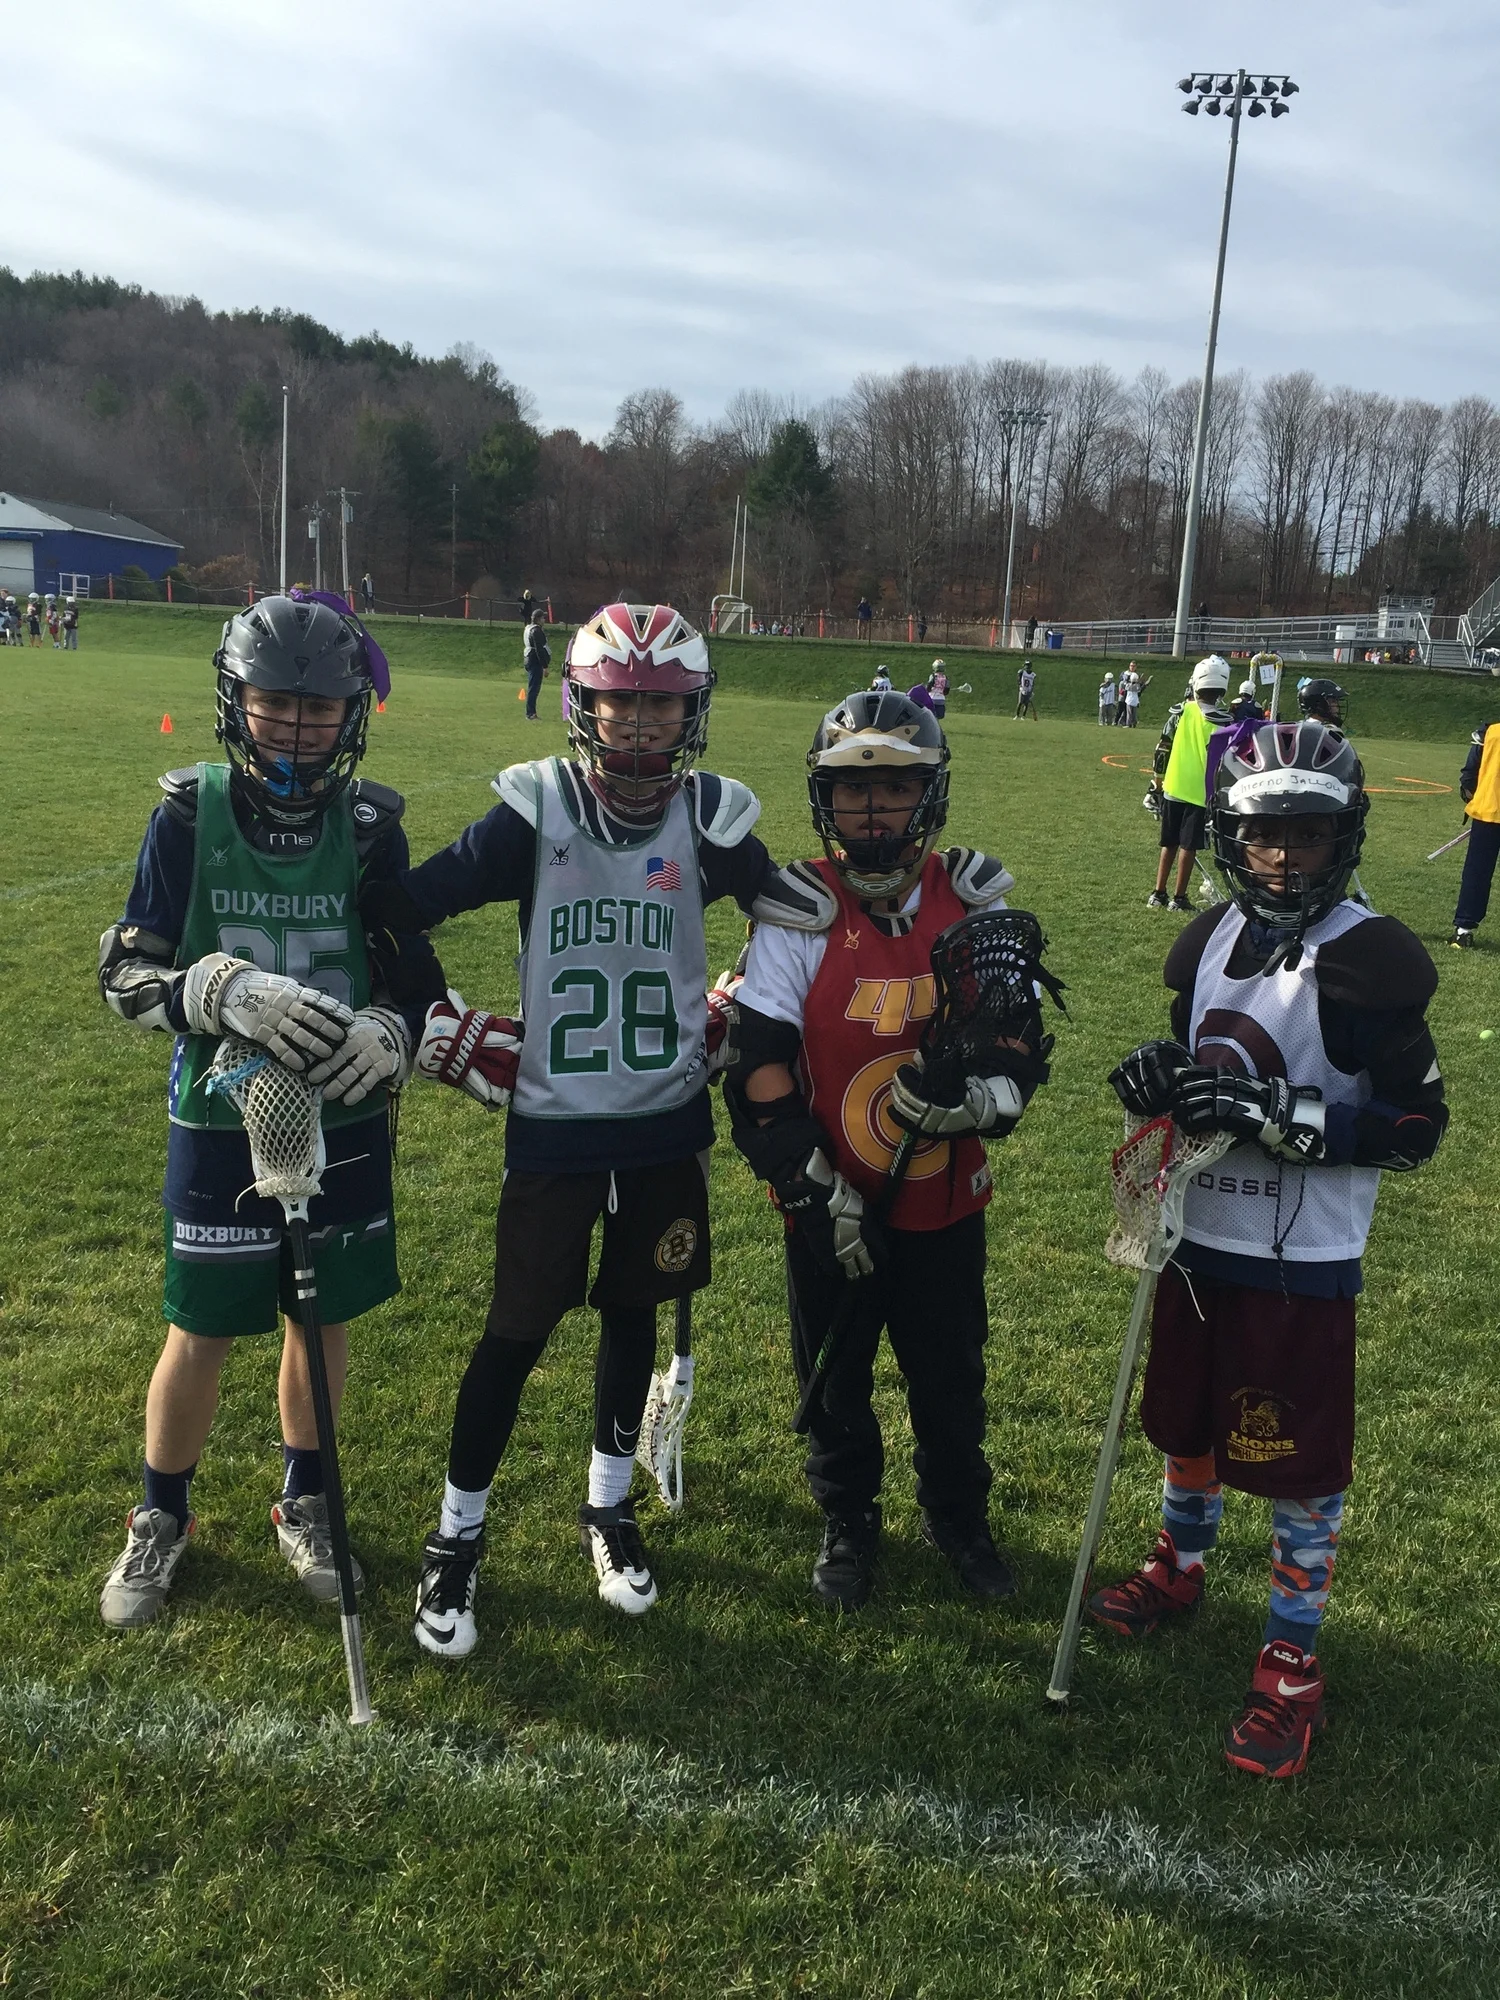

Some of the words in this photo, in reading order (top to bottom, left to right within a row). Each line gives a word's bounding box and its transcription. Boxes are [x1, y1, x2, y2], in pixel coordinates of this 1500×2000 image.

[211, 888, 347, 920] DUXBURY
[548, 896, 675, 958] BOSTON
[547, 965, 681, 1078] 28
[175, 1221, 273, 1243] DUXBURY
[1230, 1430, 1296, 1451] LIONS
